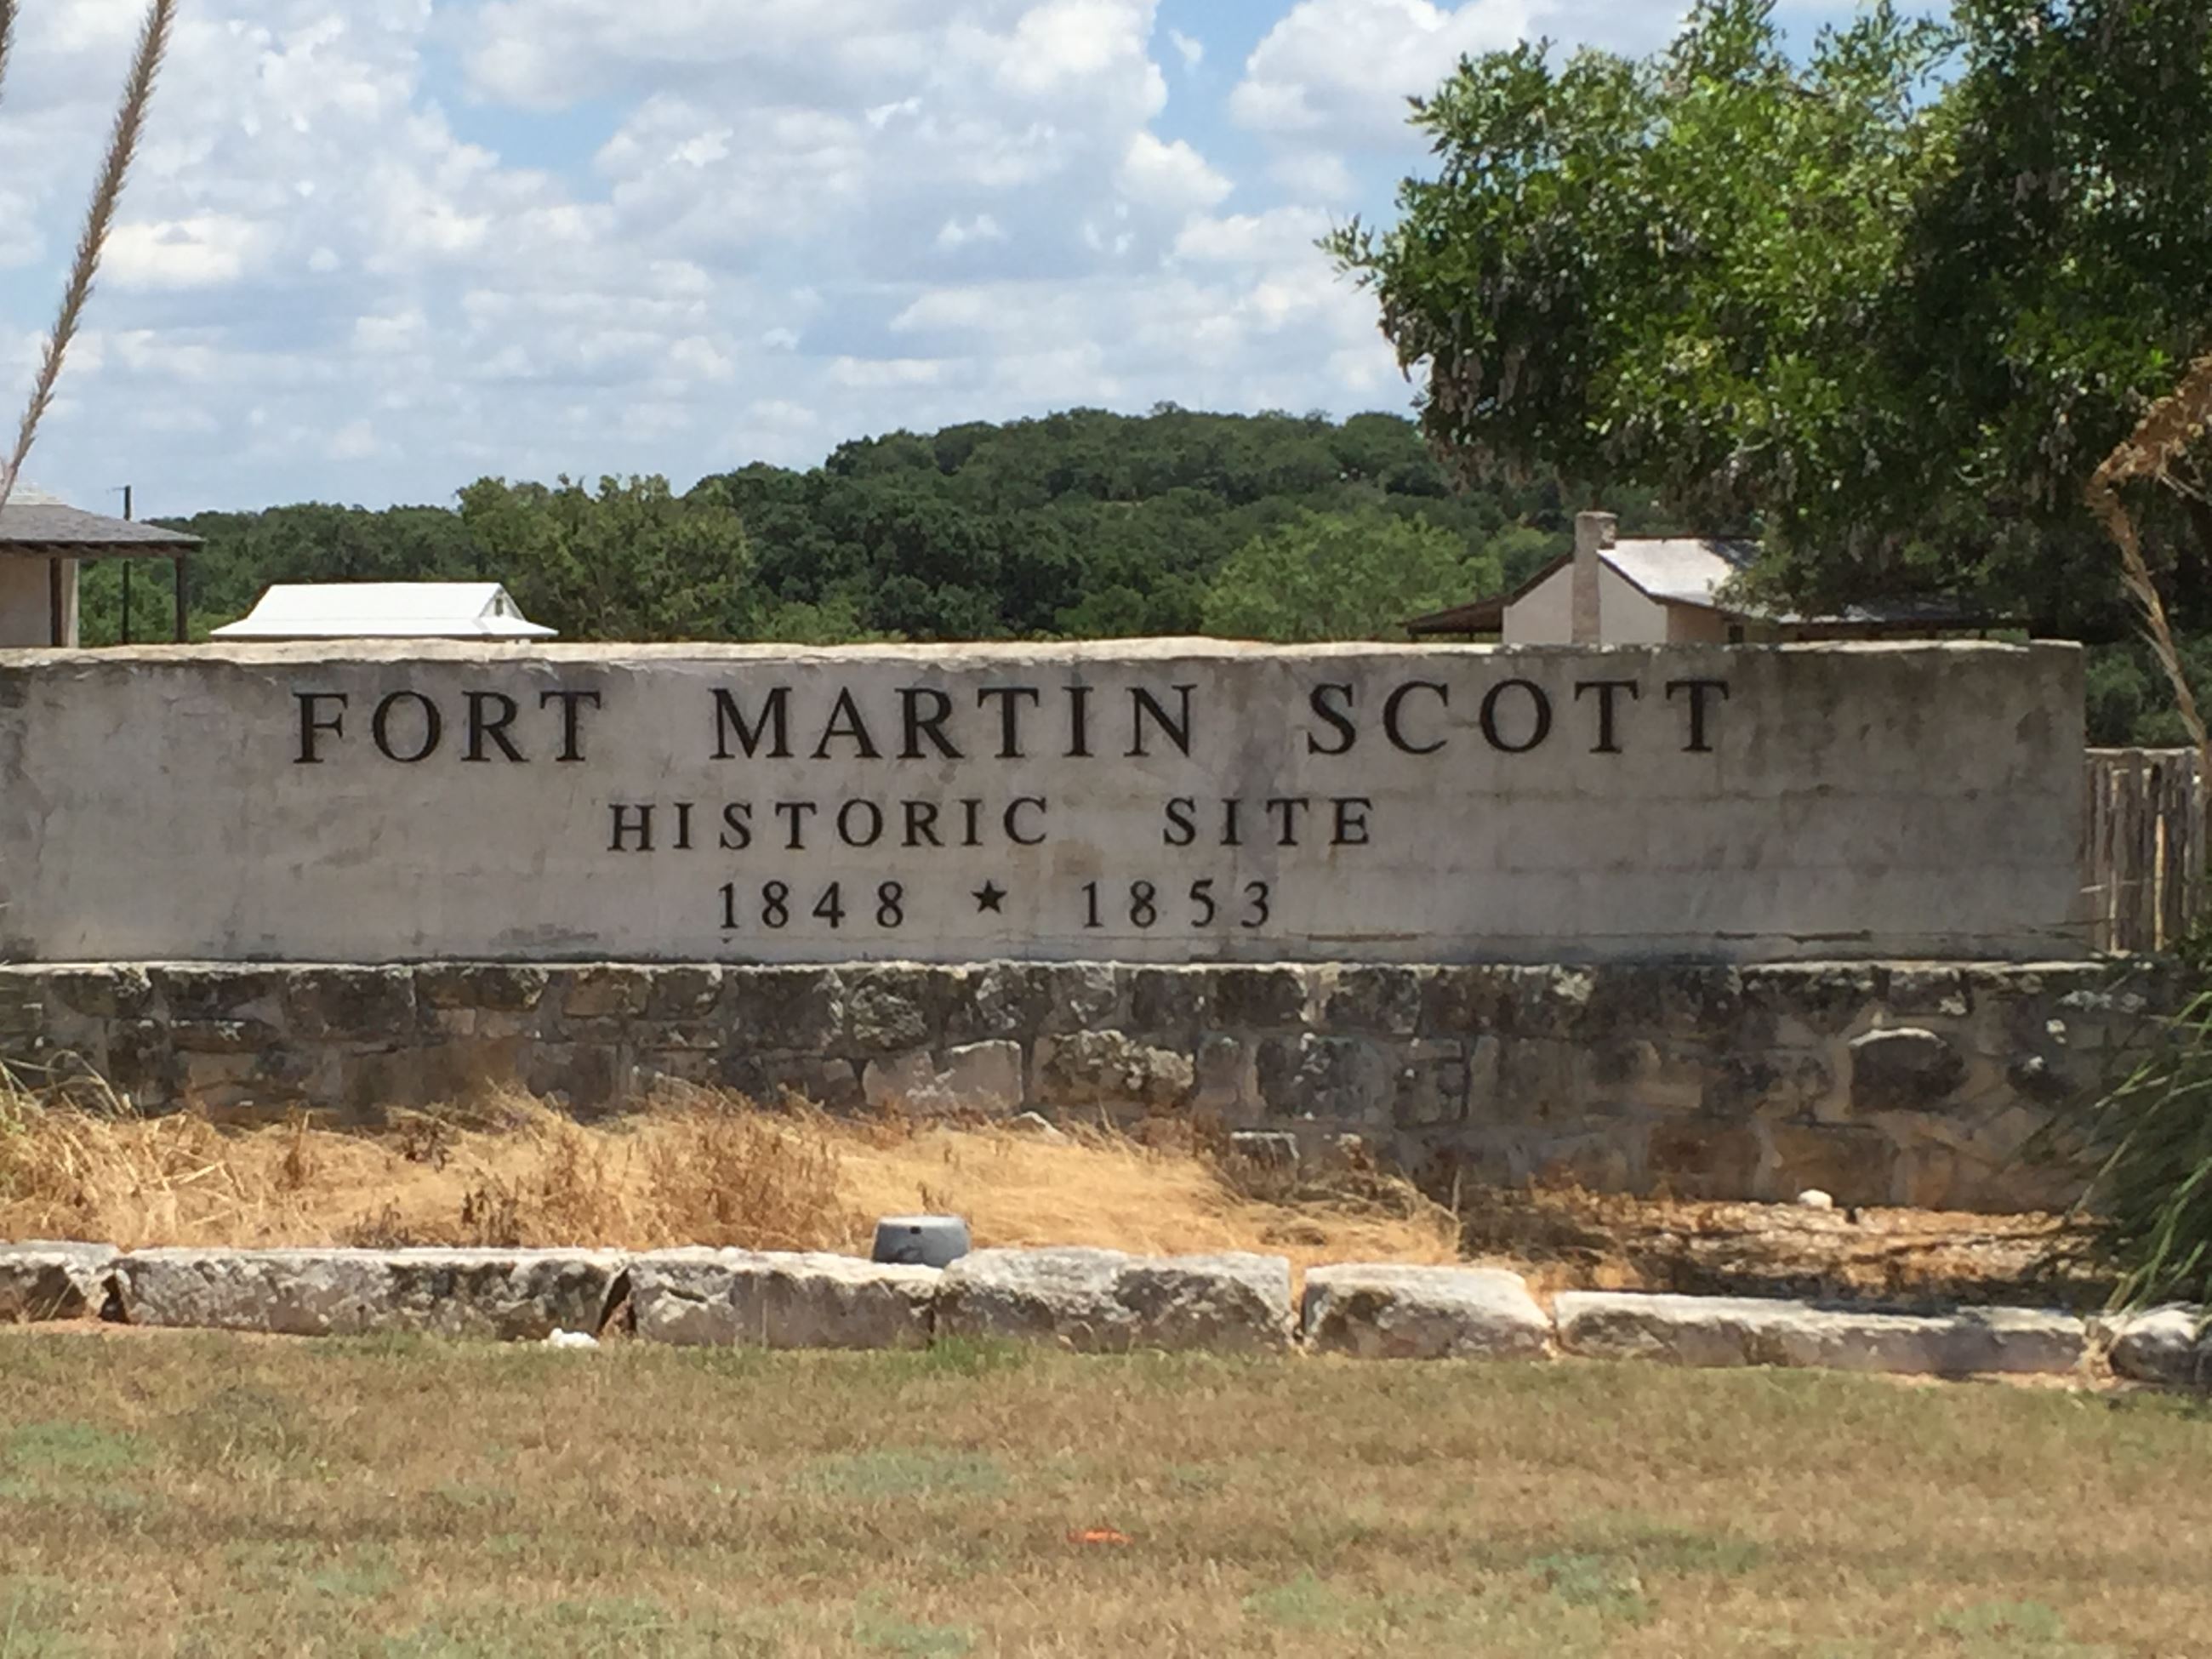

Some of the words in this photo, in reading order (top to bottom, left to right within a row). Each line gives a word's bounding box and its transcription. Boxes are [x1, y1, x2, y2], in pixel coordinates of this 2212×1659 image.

[292, 689, 603, 765] FORT
[708, 684, 1199, 761] MARTIN
[1306, 678, 1730, 755] SCOTT
[606, 796, 1049, 852] HISTORIC
[1162, 795, 1374, 848] SITE
[717, 880, 905, 930] 1848
[1080, 878, 1271, 929] 1853
